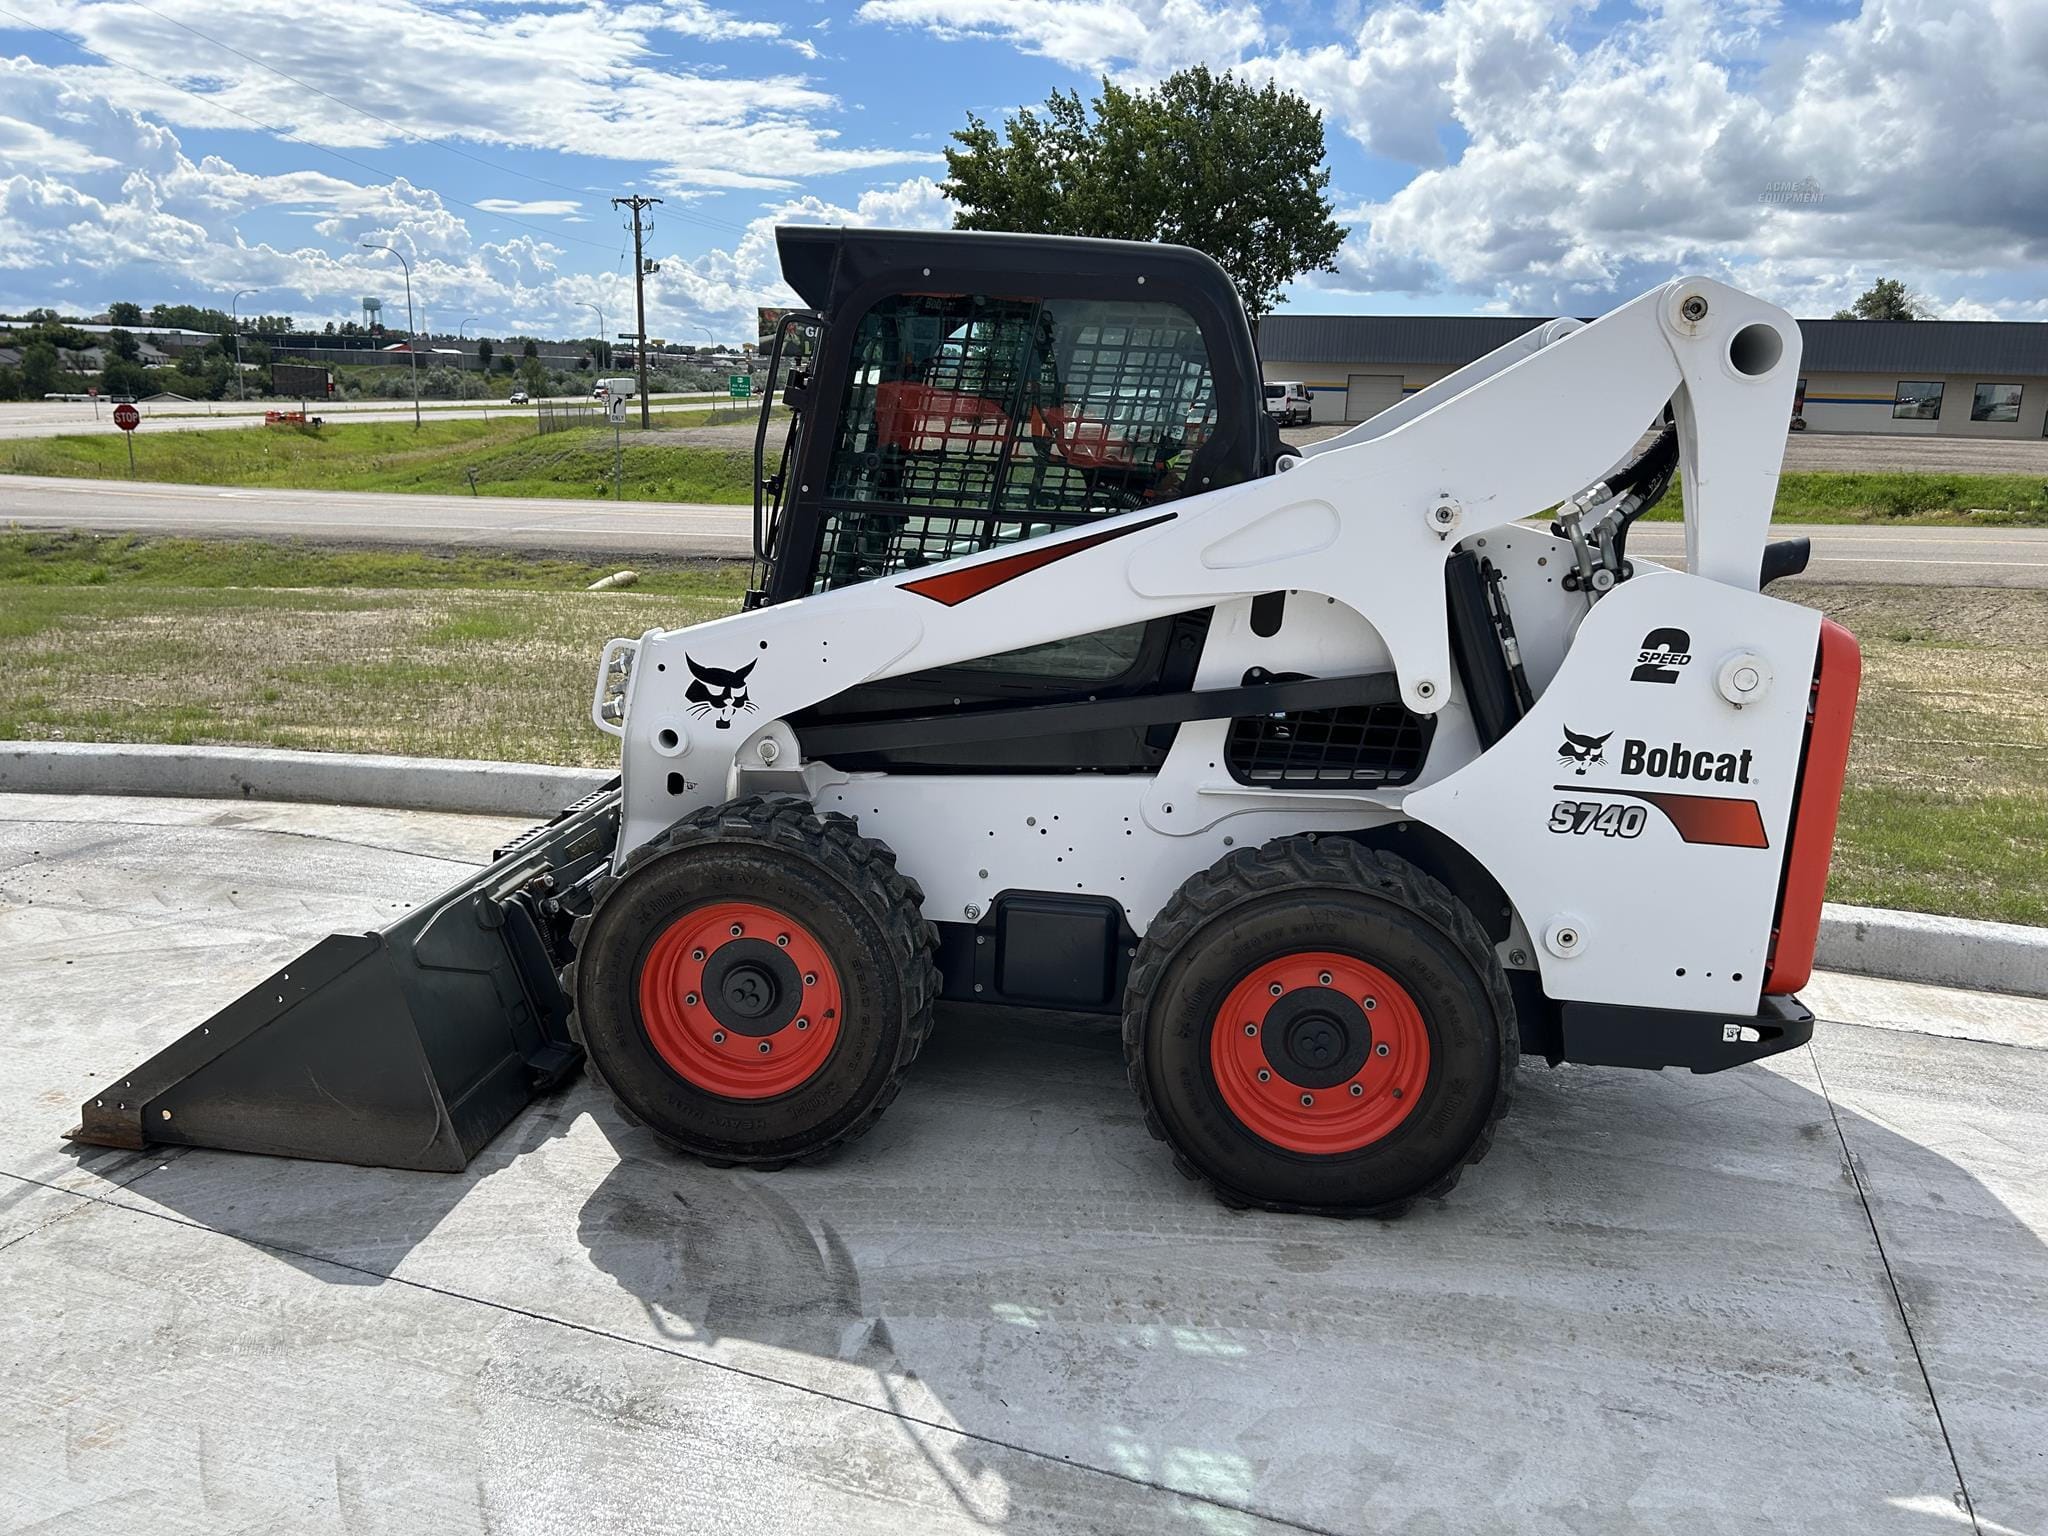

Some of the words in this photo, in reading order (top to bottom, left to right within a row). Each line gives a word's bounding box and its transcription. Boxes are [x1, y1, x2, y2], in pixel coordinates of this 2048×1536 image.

[115, 412, 138, 423] STOP
[1630, 627, 1691, 684] 2
[1637, 651, 1692, 666] SPEED
[1620, 739, 1753, 785] Bobcat
[1548, 800, 1647, 838] S740
